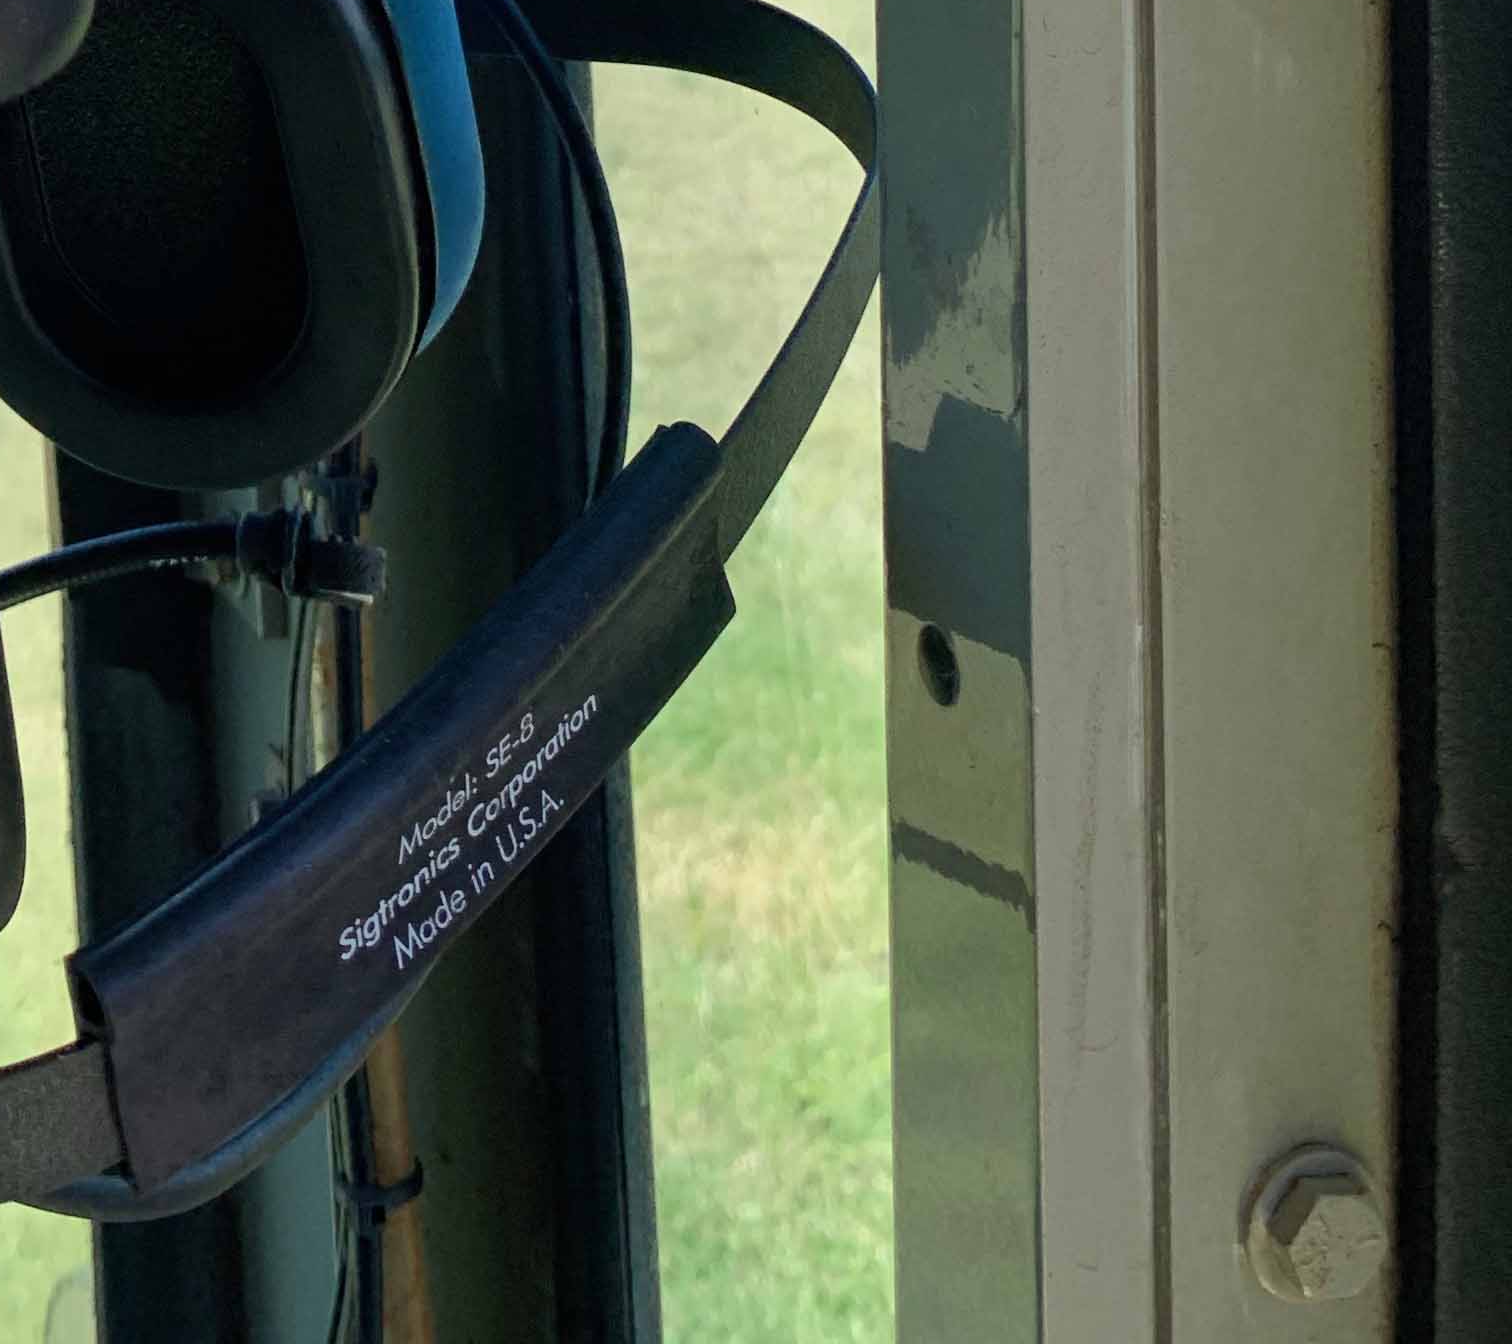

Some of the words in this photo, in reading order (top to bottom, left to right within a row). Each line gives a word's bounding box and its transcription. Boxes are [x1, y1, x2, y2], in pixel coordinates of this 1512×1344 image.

[338, 838, 461, 960] Sigtronics
[467, 694, 598, 837] Corporation
[393, 888, 467, 970] Made
[468, 861, 495, 895] in
[495, 788, 565, 863] U.S.A.
[398, 773, 478, 864] Model:
[485, 712, 536, 778] SE-8
